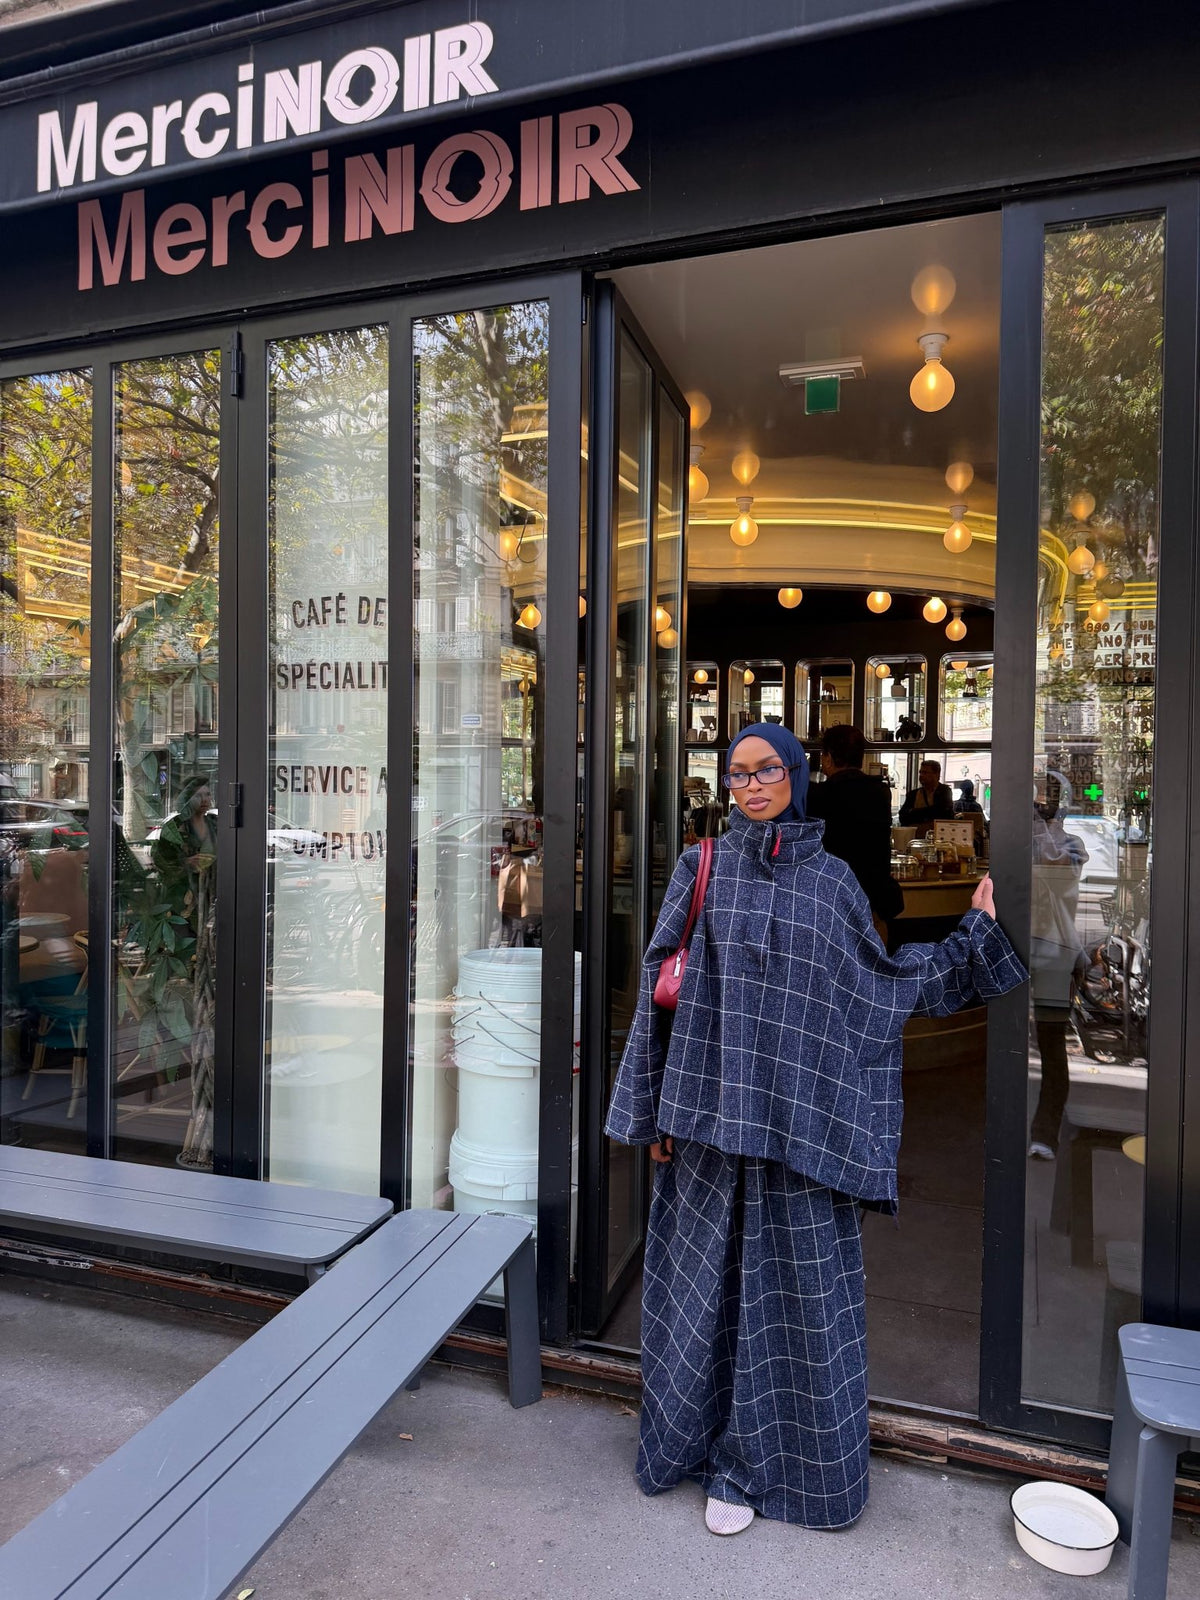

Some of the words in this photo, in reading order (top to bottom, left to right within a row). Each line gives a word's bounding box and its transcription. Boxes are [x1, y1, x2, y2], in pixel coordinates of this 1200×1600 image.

[292, 592, 347, 628] CAFÉ
[358, 595, 387, 627] DE
[276, 659, 388, 690] SPÉCIALIT
[276, 765, 368, 794] SERVICE
